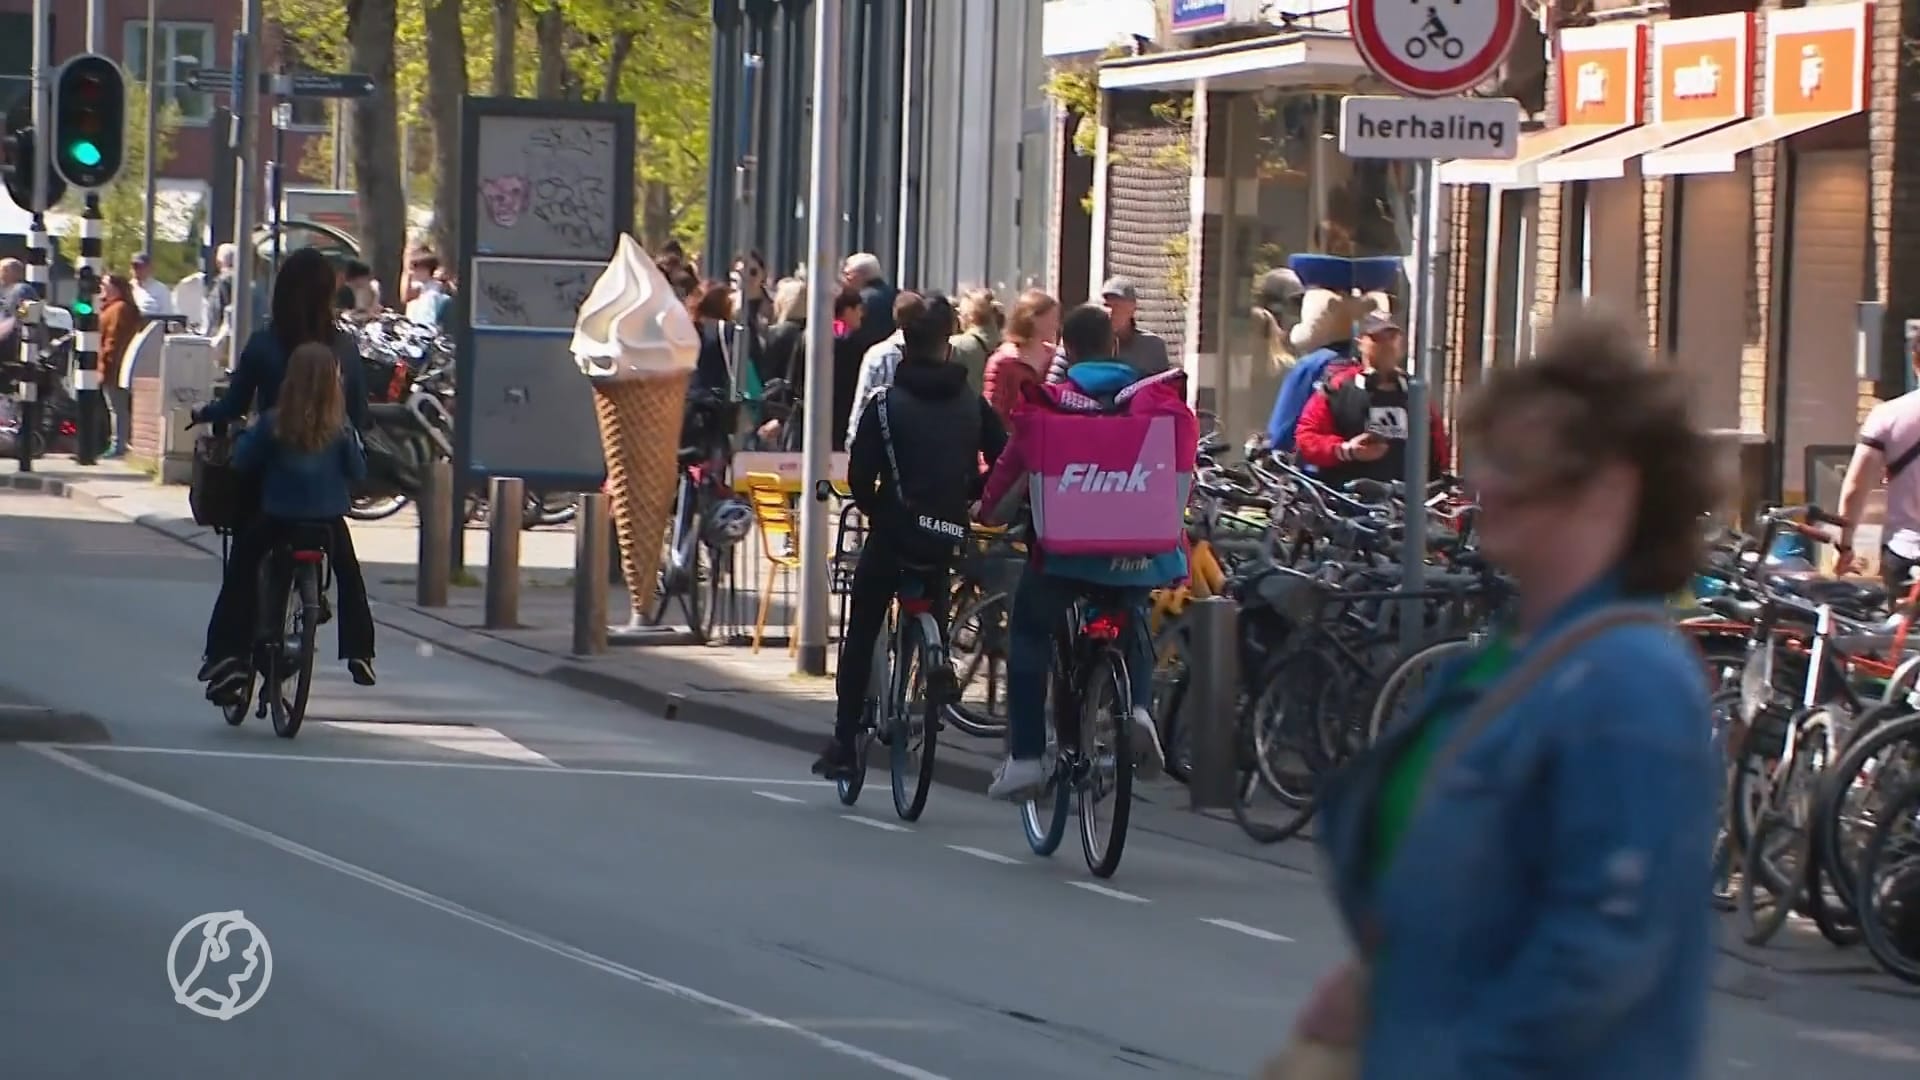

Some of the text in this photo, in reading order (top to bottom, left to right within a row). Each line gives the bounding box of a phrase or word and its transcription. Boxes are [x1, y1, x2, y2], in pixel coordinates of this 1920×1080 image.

[1358, 112, 1504, 147] herhaling
[1057, 463, 1152, 493] Flink
[919, 515, 964, 538] SEASIDE
